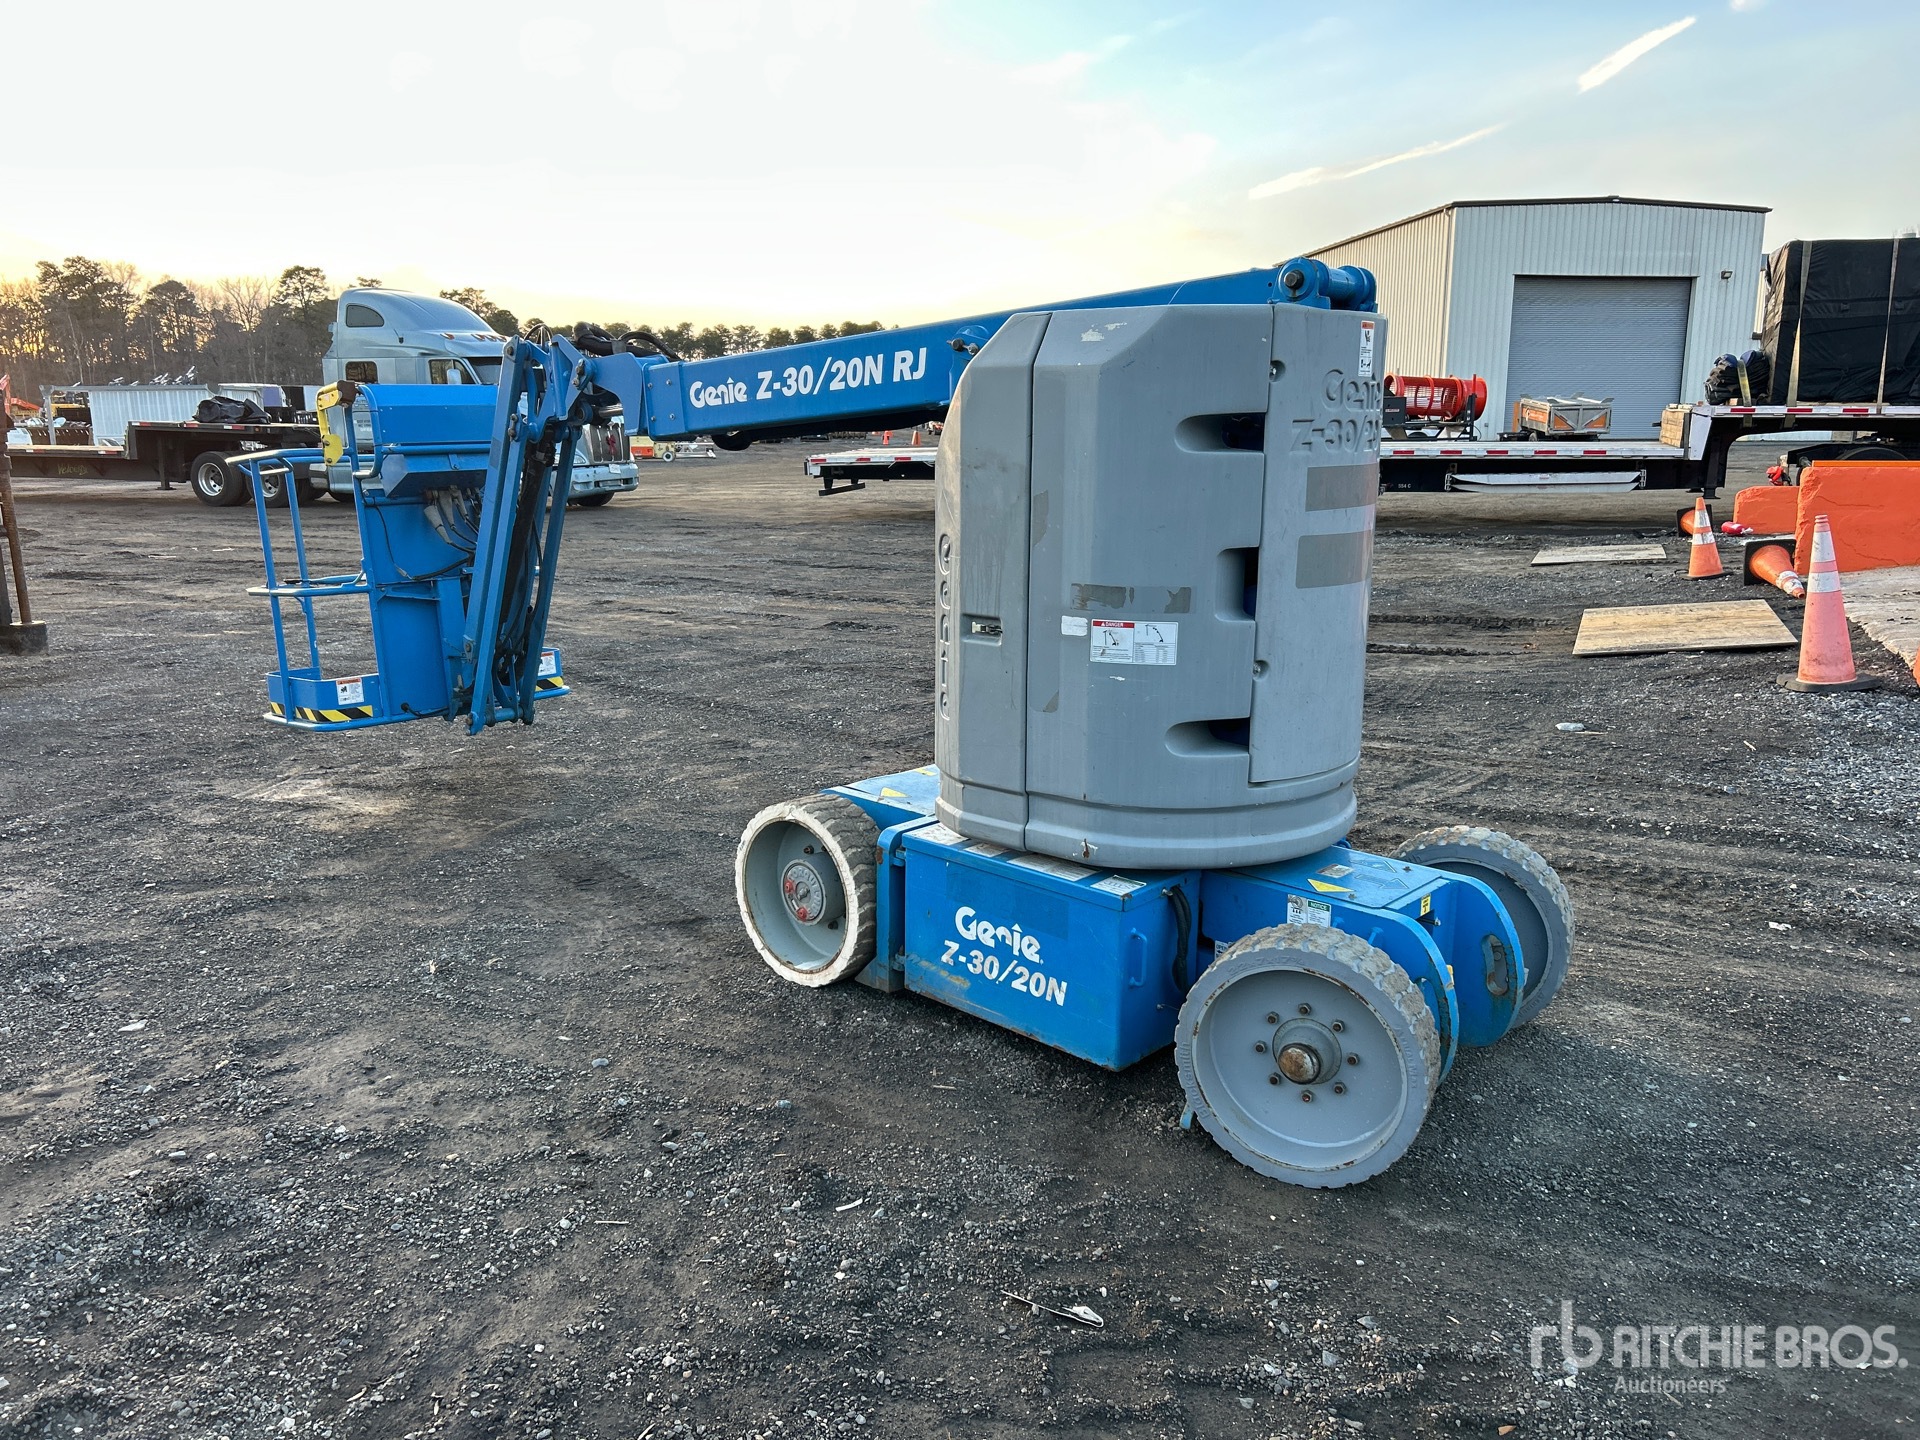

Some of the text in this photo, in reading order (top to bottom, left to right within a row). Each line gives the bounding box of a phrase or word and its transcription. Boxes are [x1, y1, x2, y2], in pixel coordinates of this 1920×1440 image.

[690, 347, 927, 408] Genie Z-30/20N RJ
[938, 534, 952, 721] Genie
[955, 906, 1042, 963] Genie
[940, 940, 1068, 1007] Z-30/20N
